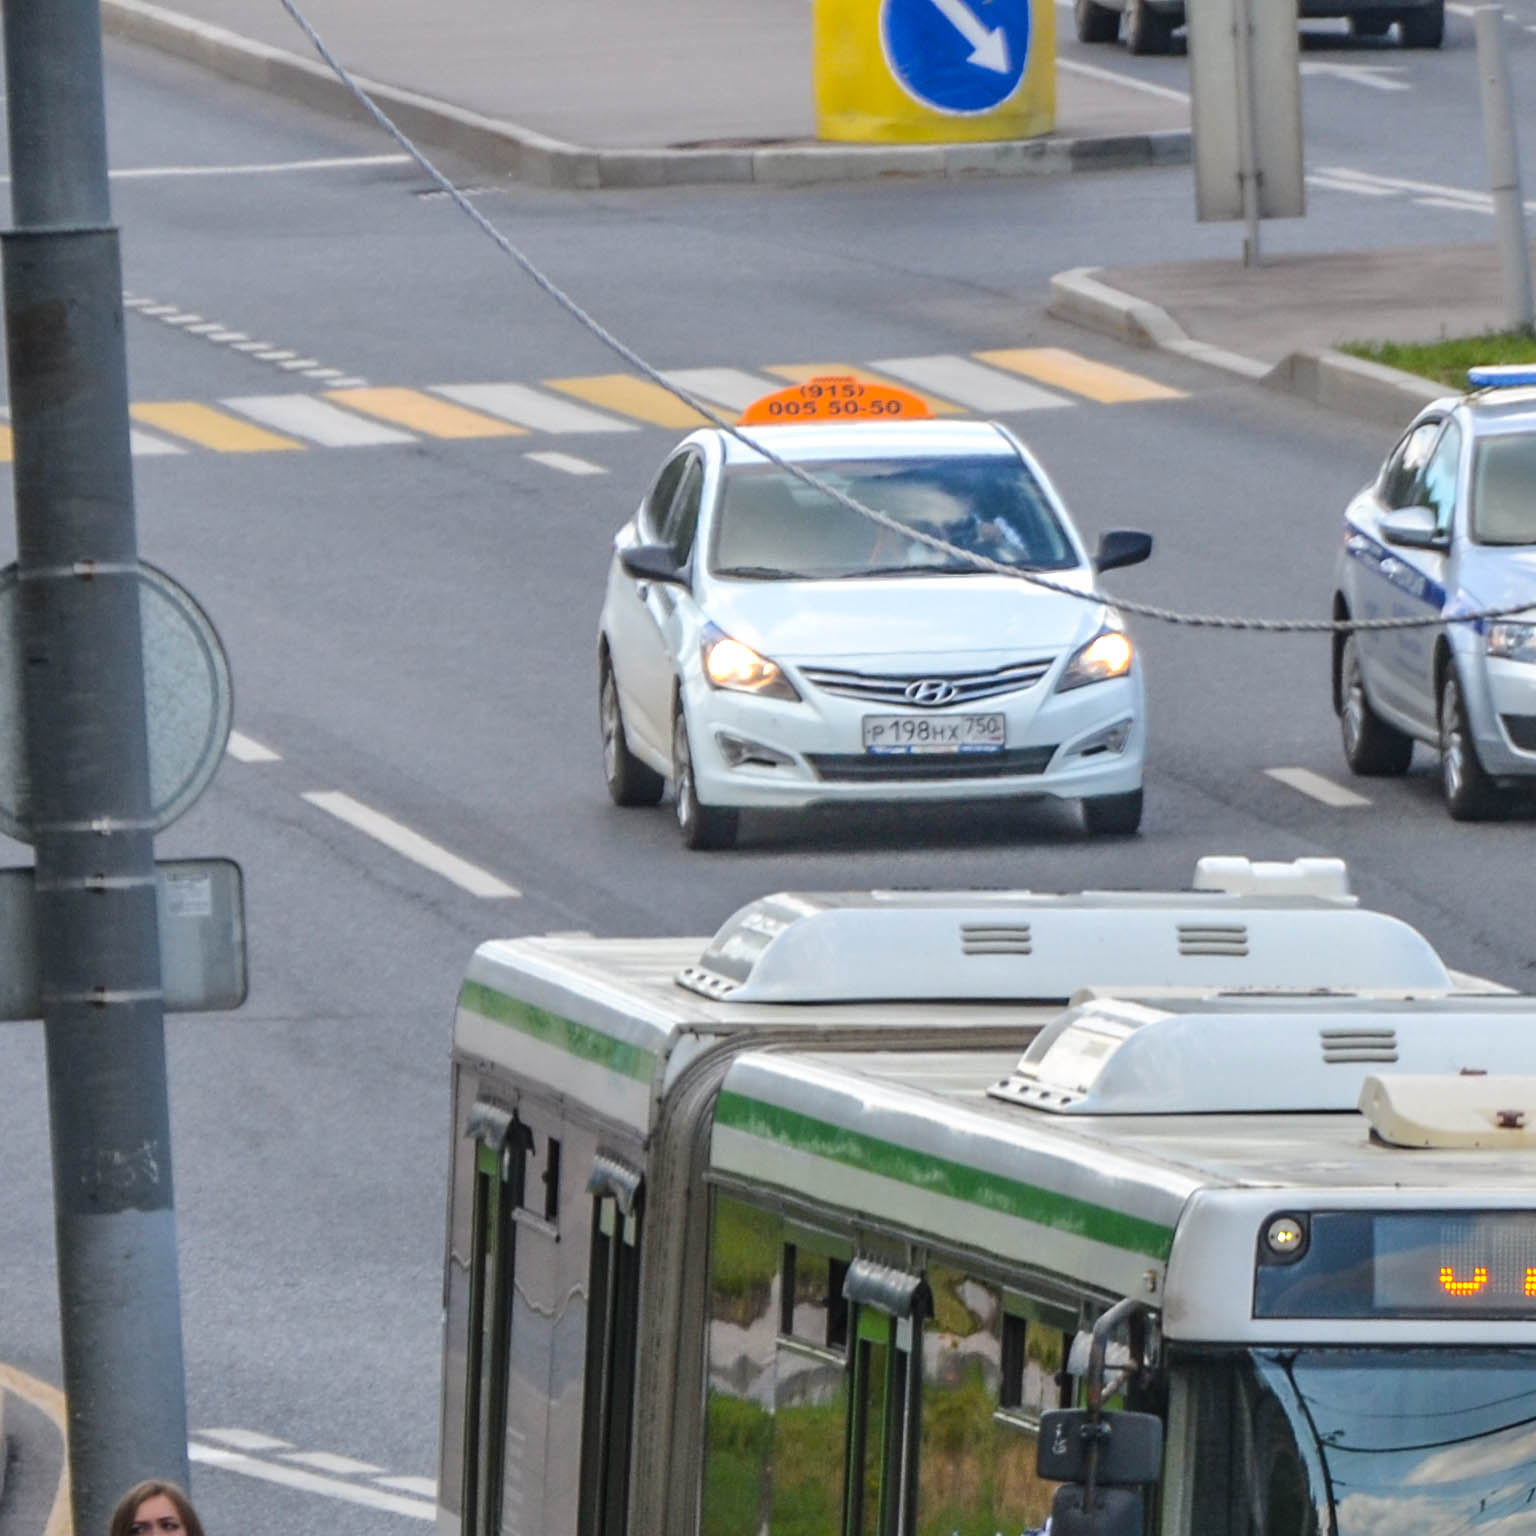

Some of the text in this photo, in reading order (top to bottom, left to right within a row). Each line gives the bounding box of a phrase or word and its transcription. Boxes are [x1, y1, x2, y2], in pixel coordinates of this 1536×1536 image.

[799, 384, 866, 399] (915)
[768, 400, 902, 416] 005 50-50
